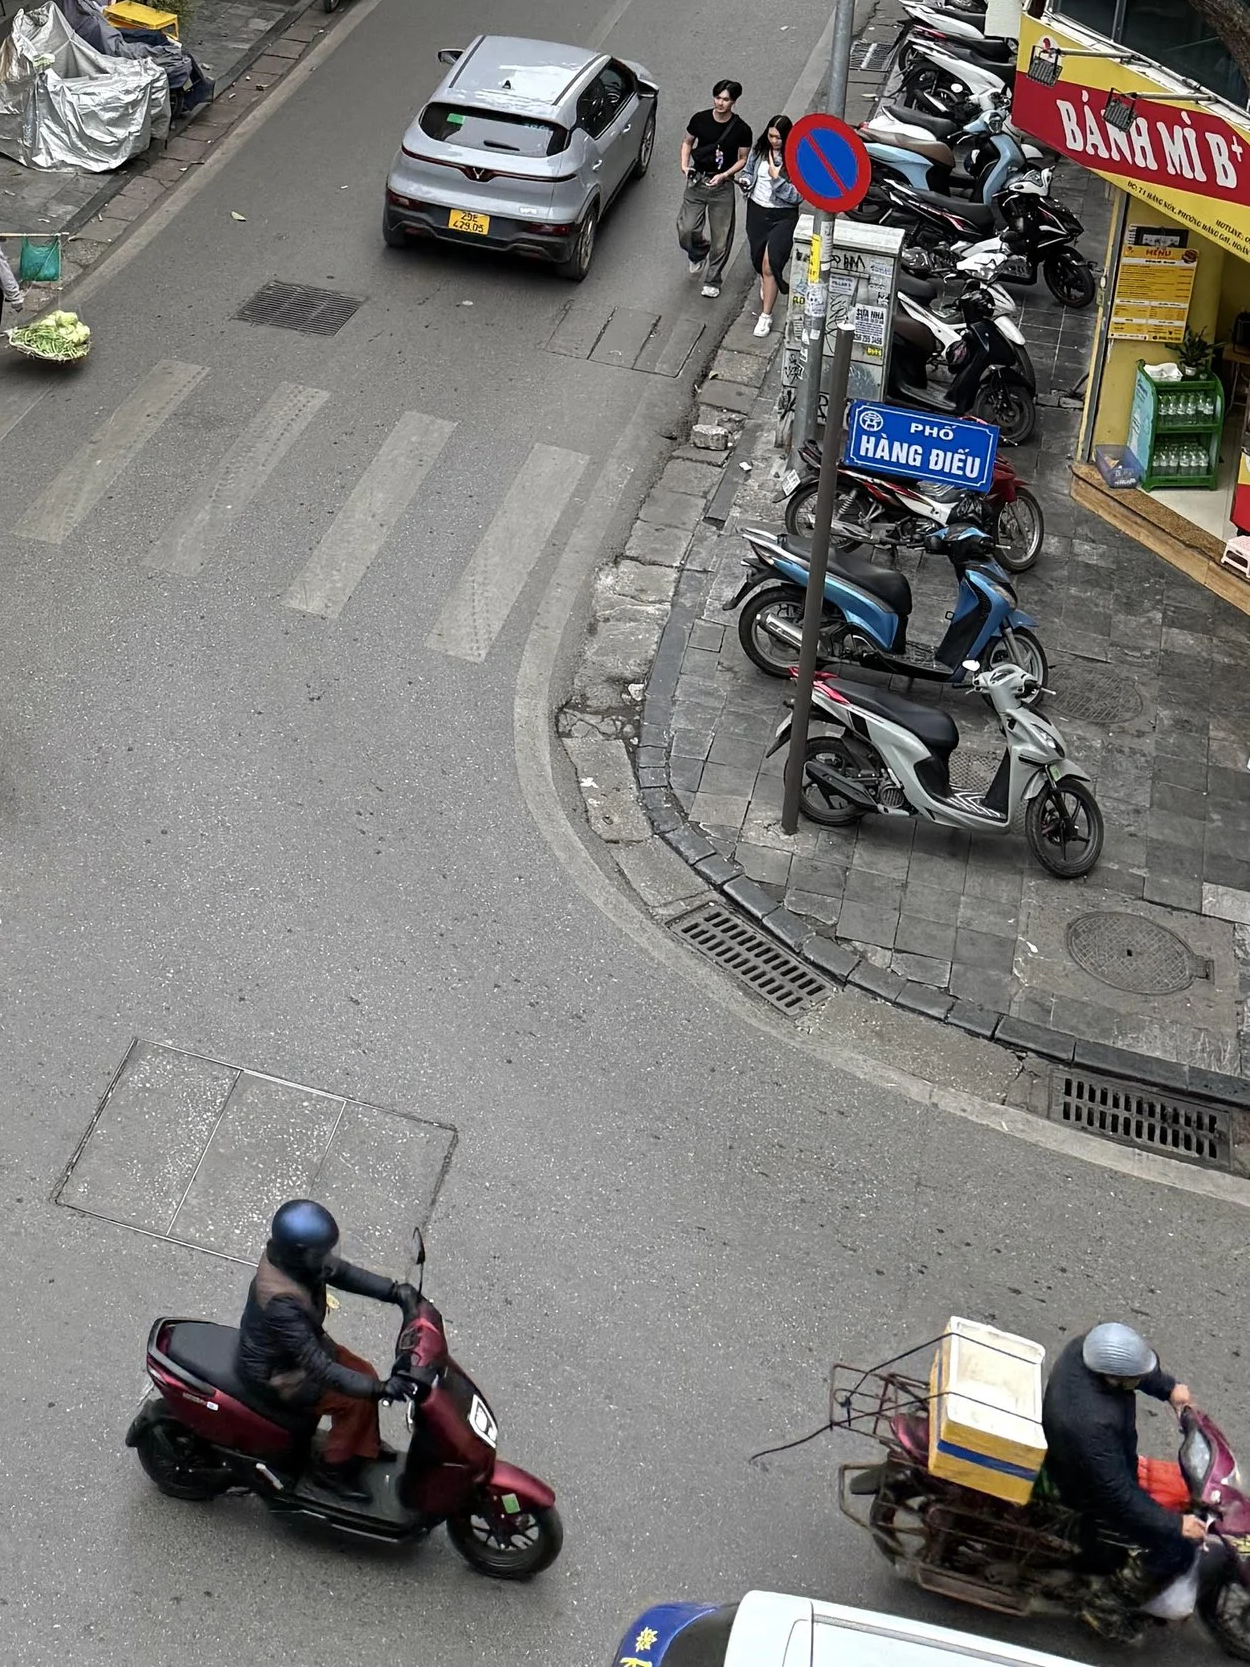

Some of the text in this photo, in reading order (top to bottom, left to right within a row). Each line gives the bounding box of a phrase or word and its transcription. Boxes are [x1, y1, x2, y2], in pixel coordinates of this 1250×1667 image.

[1056, 90, 1158, 170] BÁNH
[1157, 111, 1207, 182] MÌ
[910, 422, 957, 441] PHỐ
[859, 432, 981, 479] HÀNG ĐIẾU
